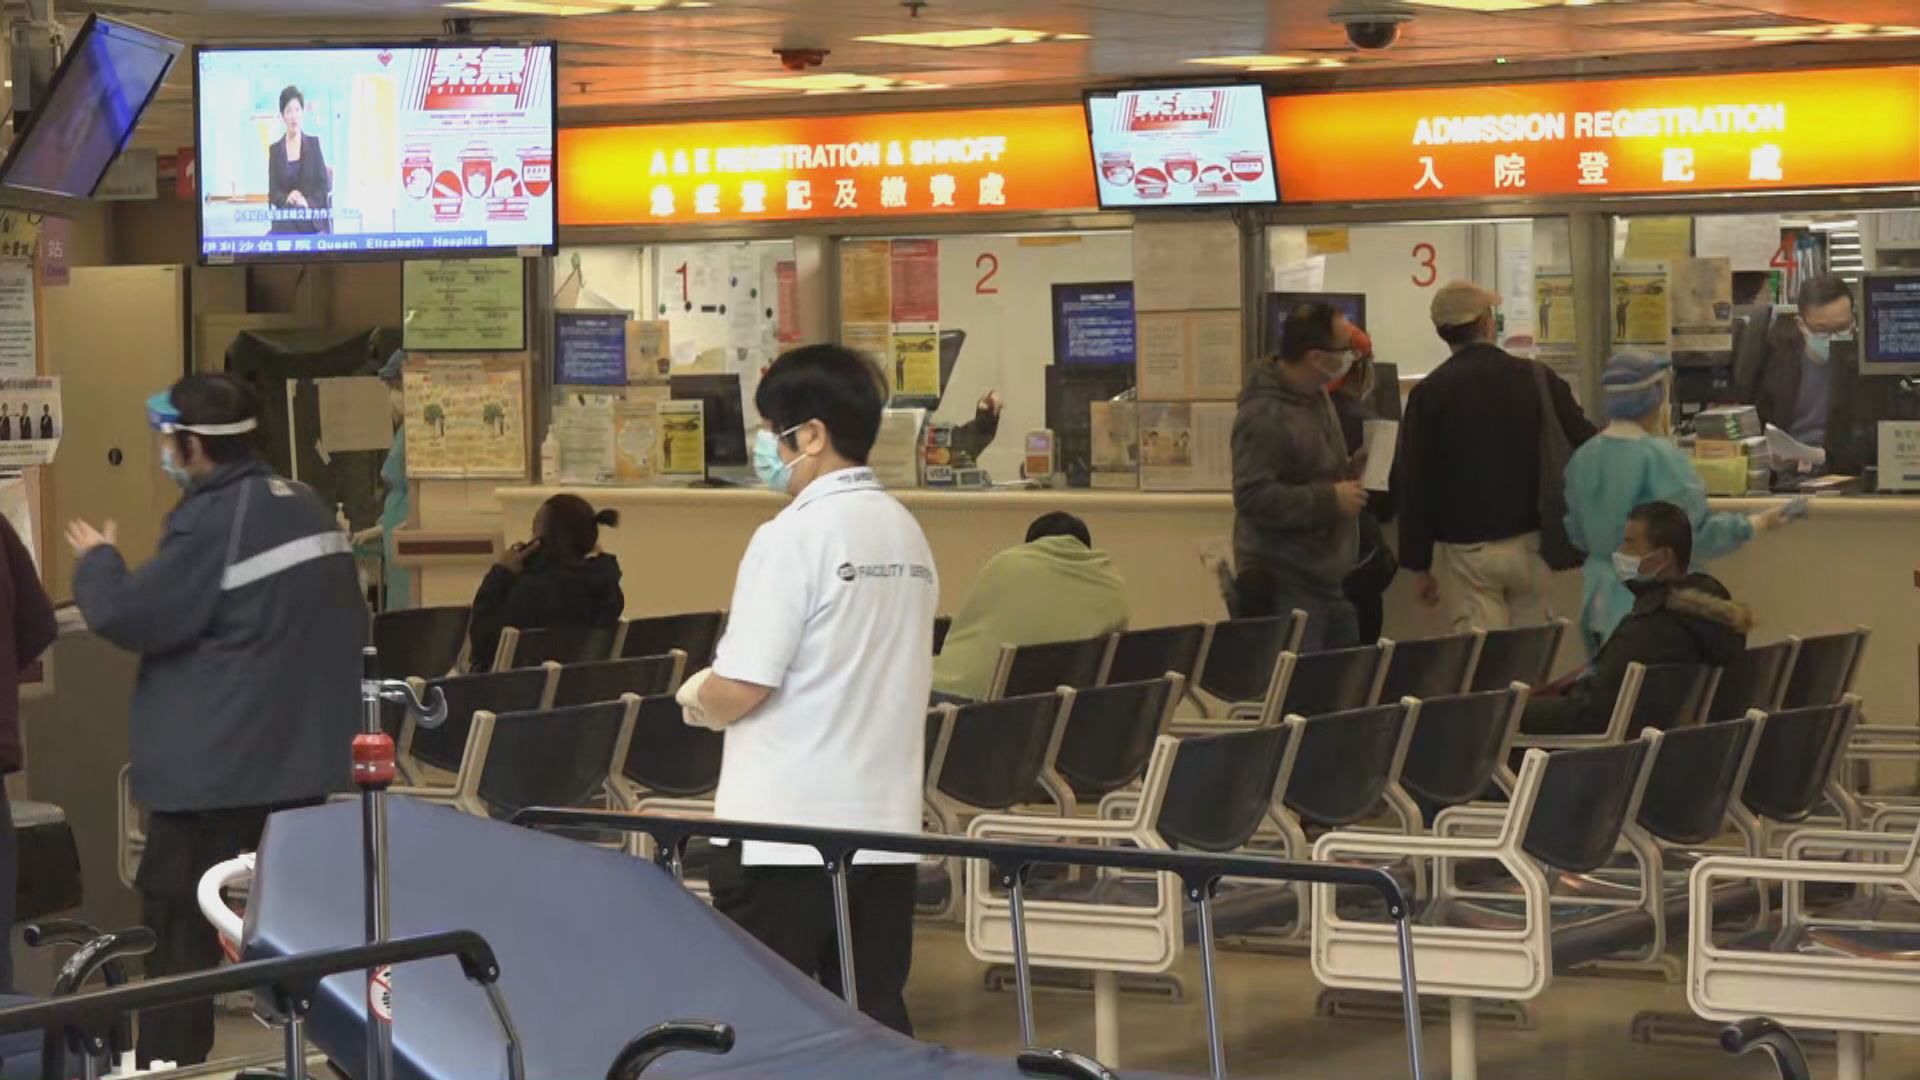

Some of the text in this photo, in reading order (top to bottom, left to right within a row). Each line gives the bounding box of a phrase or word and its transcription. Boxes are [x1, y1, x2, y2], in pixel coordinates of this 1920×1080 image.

[1412, 104, 1785, 145] ADMISSION REGISTRATION
[717, 142, 880, 172] REGISTRATION
[910, 136, 1006, 165] SHROFF
[1413, 144, 1783, 190] 入院登記處
[317, 240, 357, 249] Queen
[366, 237, 425, 249] Elizabeth
[433, 235, 483, 248] Hospital
[1770, 233, 1799, 277] 4
[676, 261, 688, 301] 1
[975, 253, 999, 294] 2
[1411, 243, 1437, 287] 3
[929, 467, 951, 478] VISA
[858, 564, 904, 578] FACILITY
